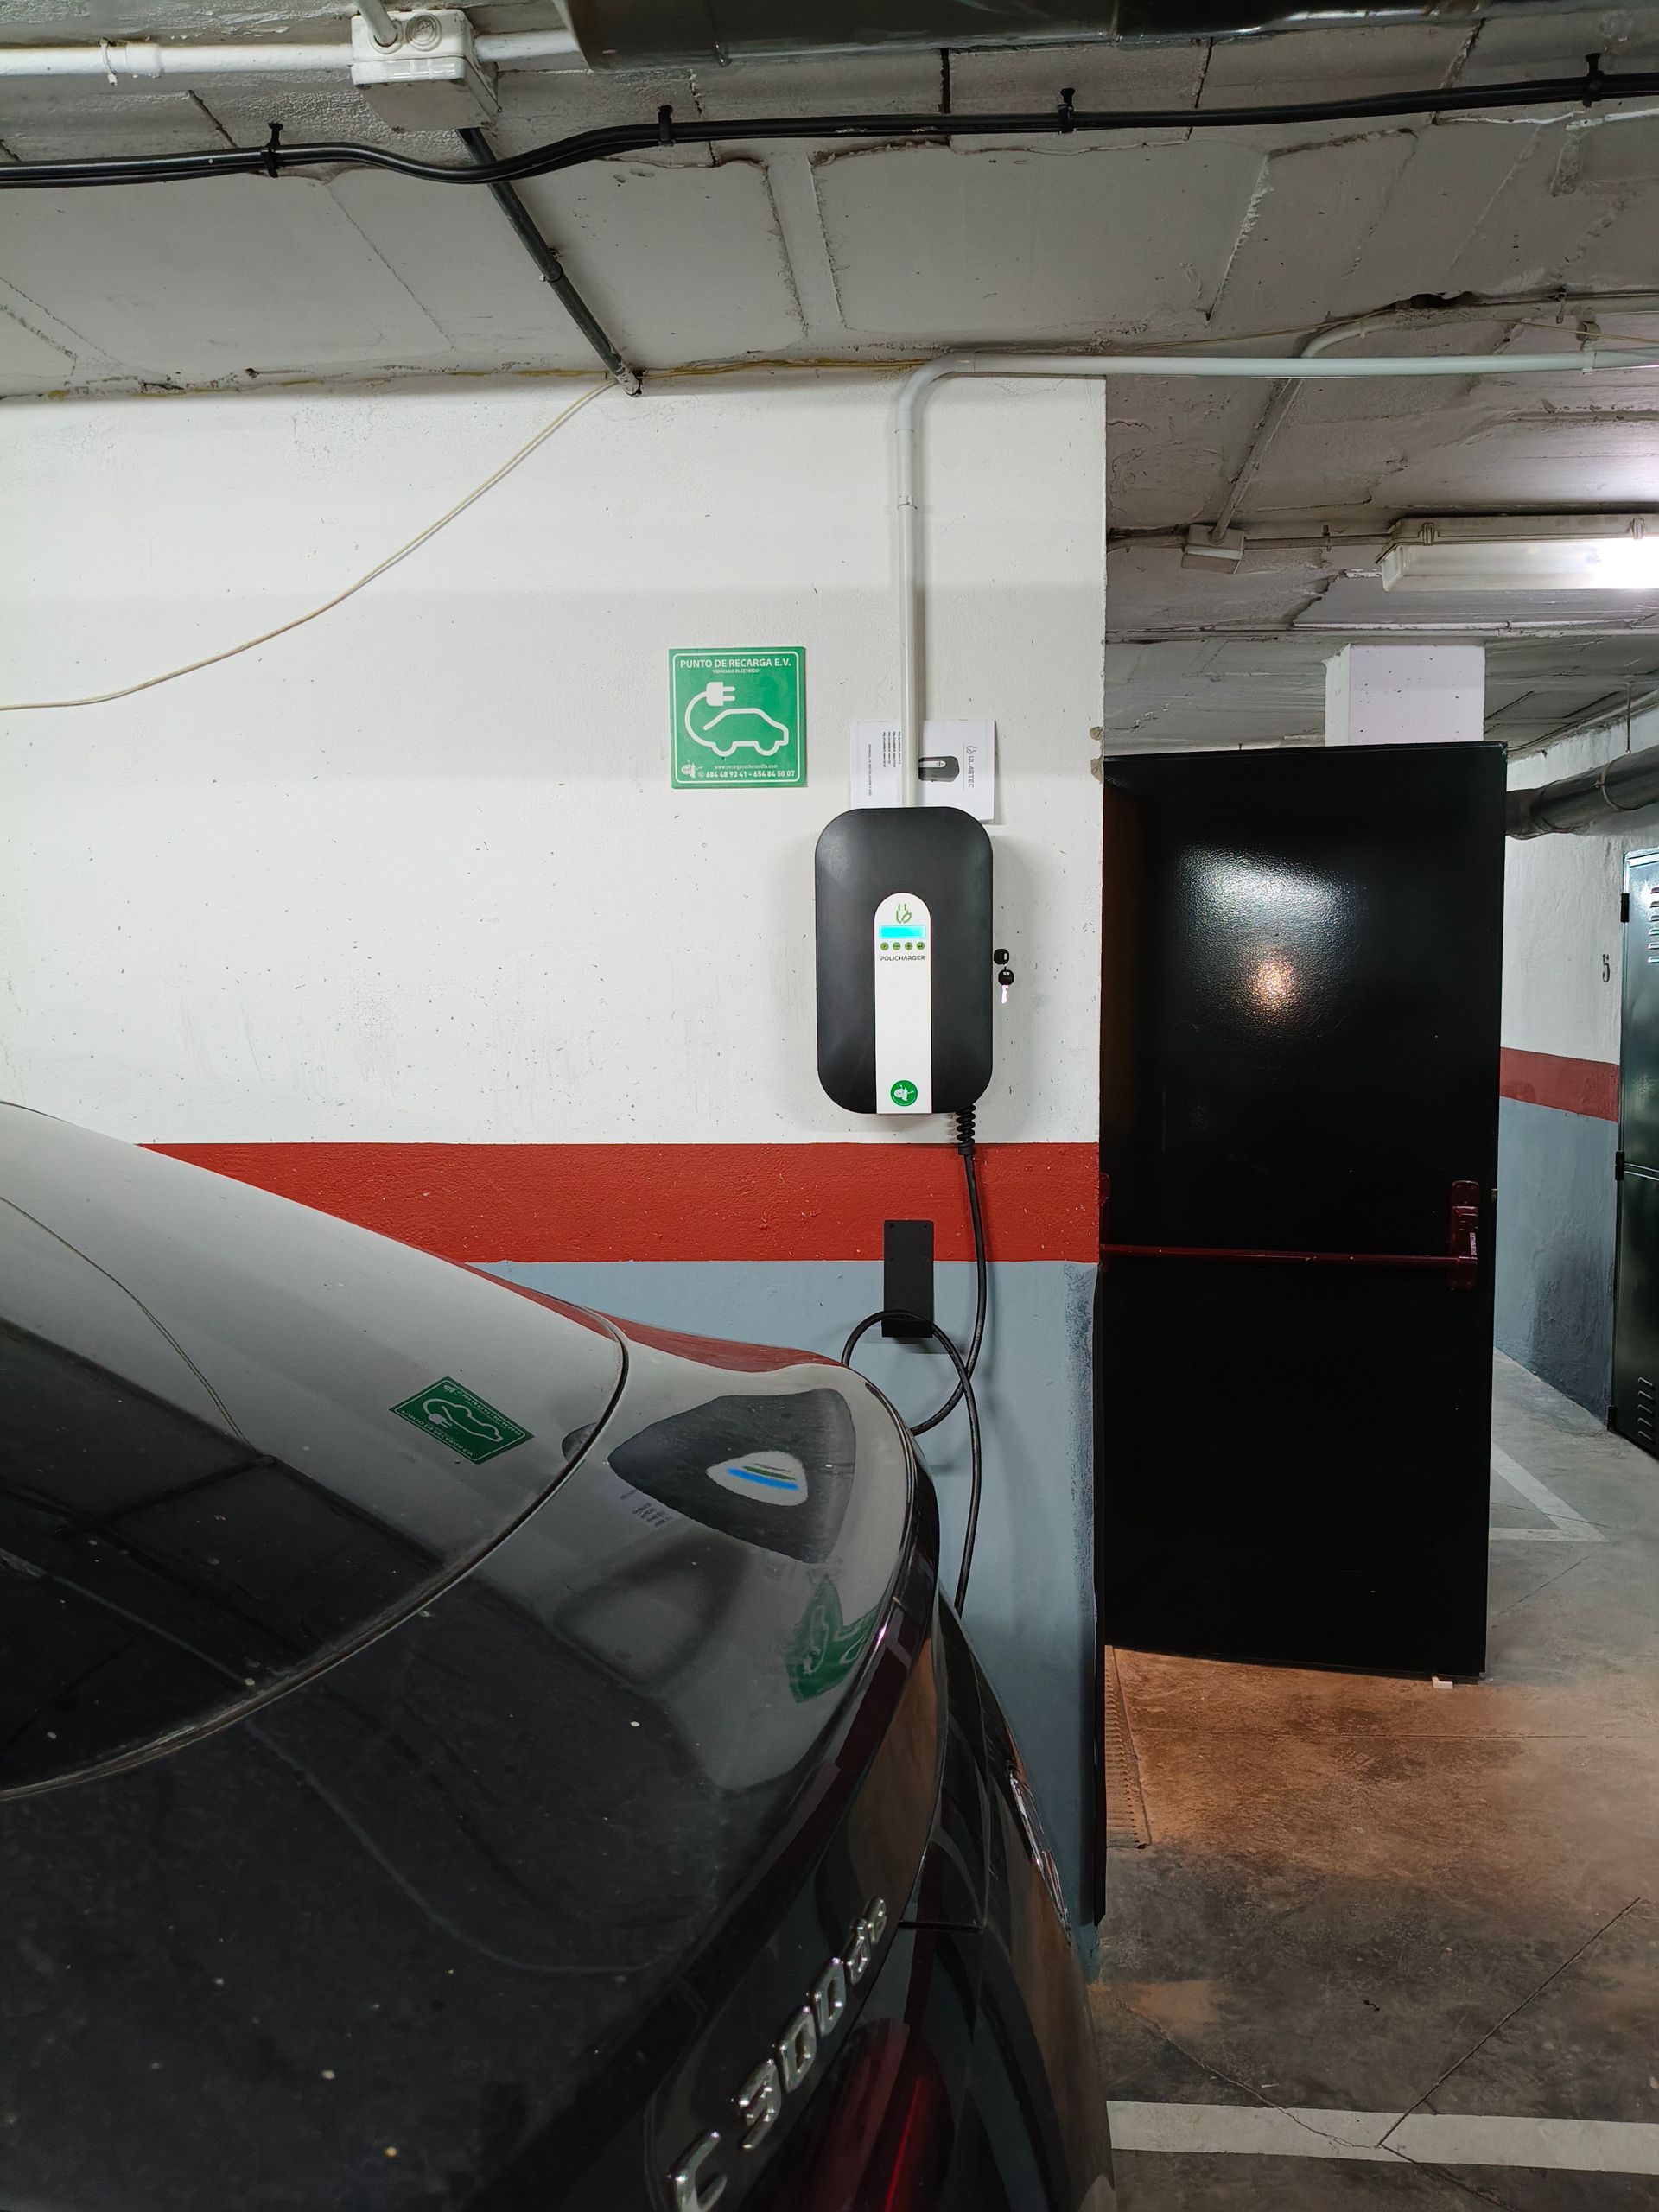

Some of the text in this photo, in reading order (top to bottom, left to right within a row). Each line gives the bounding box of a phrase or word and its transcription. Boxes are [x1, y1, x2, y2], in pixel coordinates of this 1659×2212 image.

[680, 659, 712, 668] PUNTO
[728, 658, 772, 667] RECARGA
[774, 658, 791, 666] E.V.
[1602, 953, 1611, 982] 5
[669, 2129, 728, 2212] C
